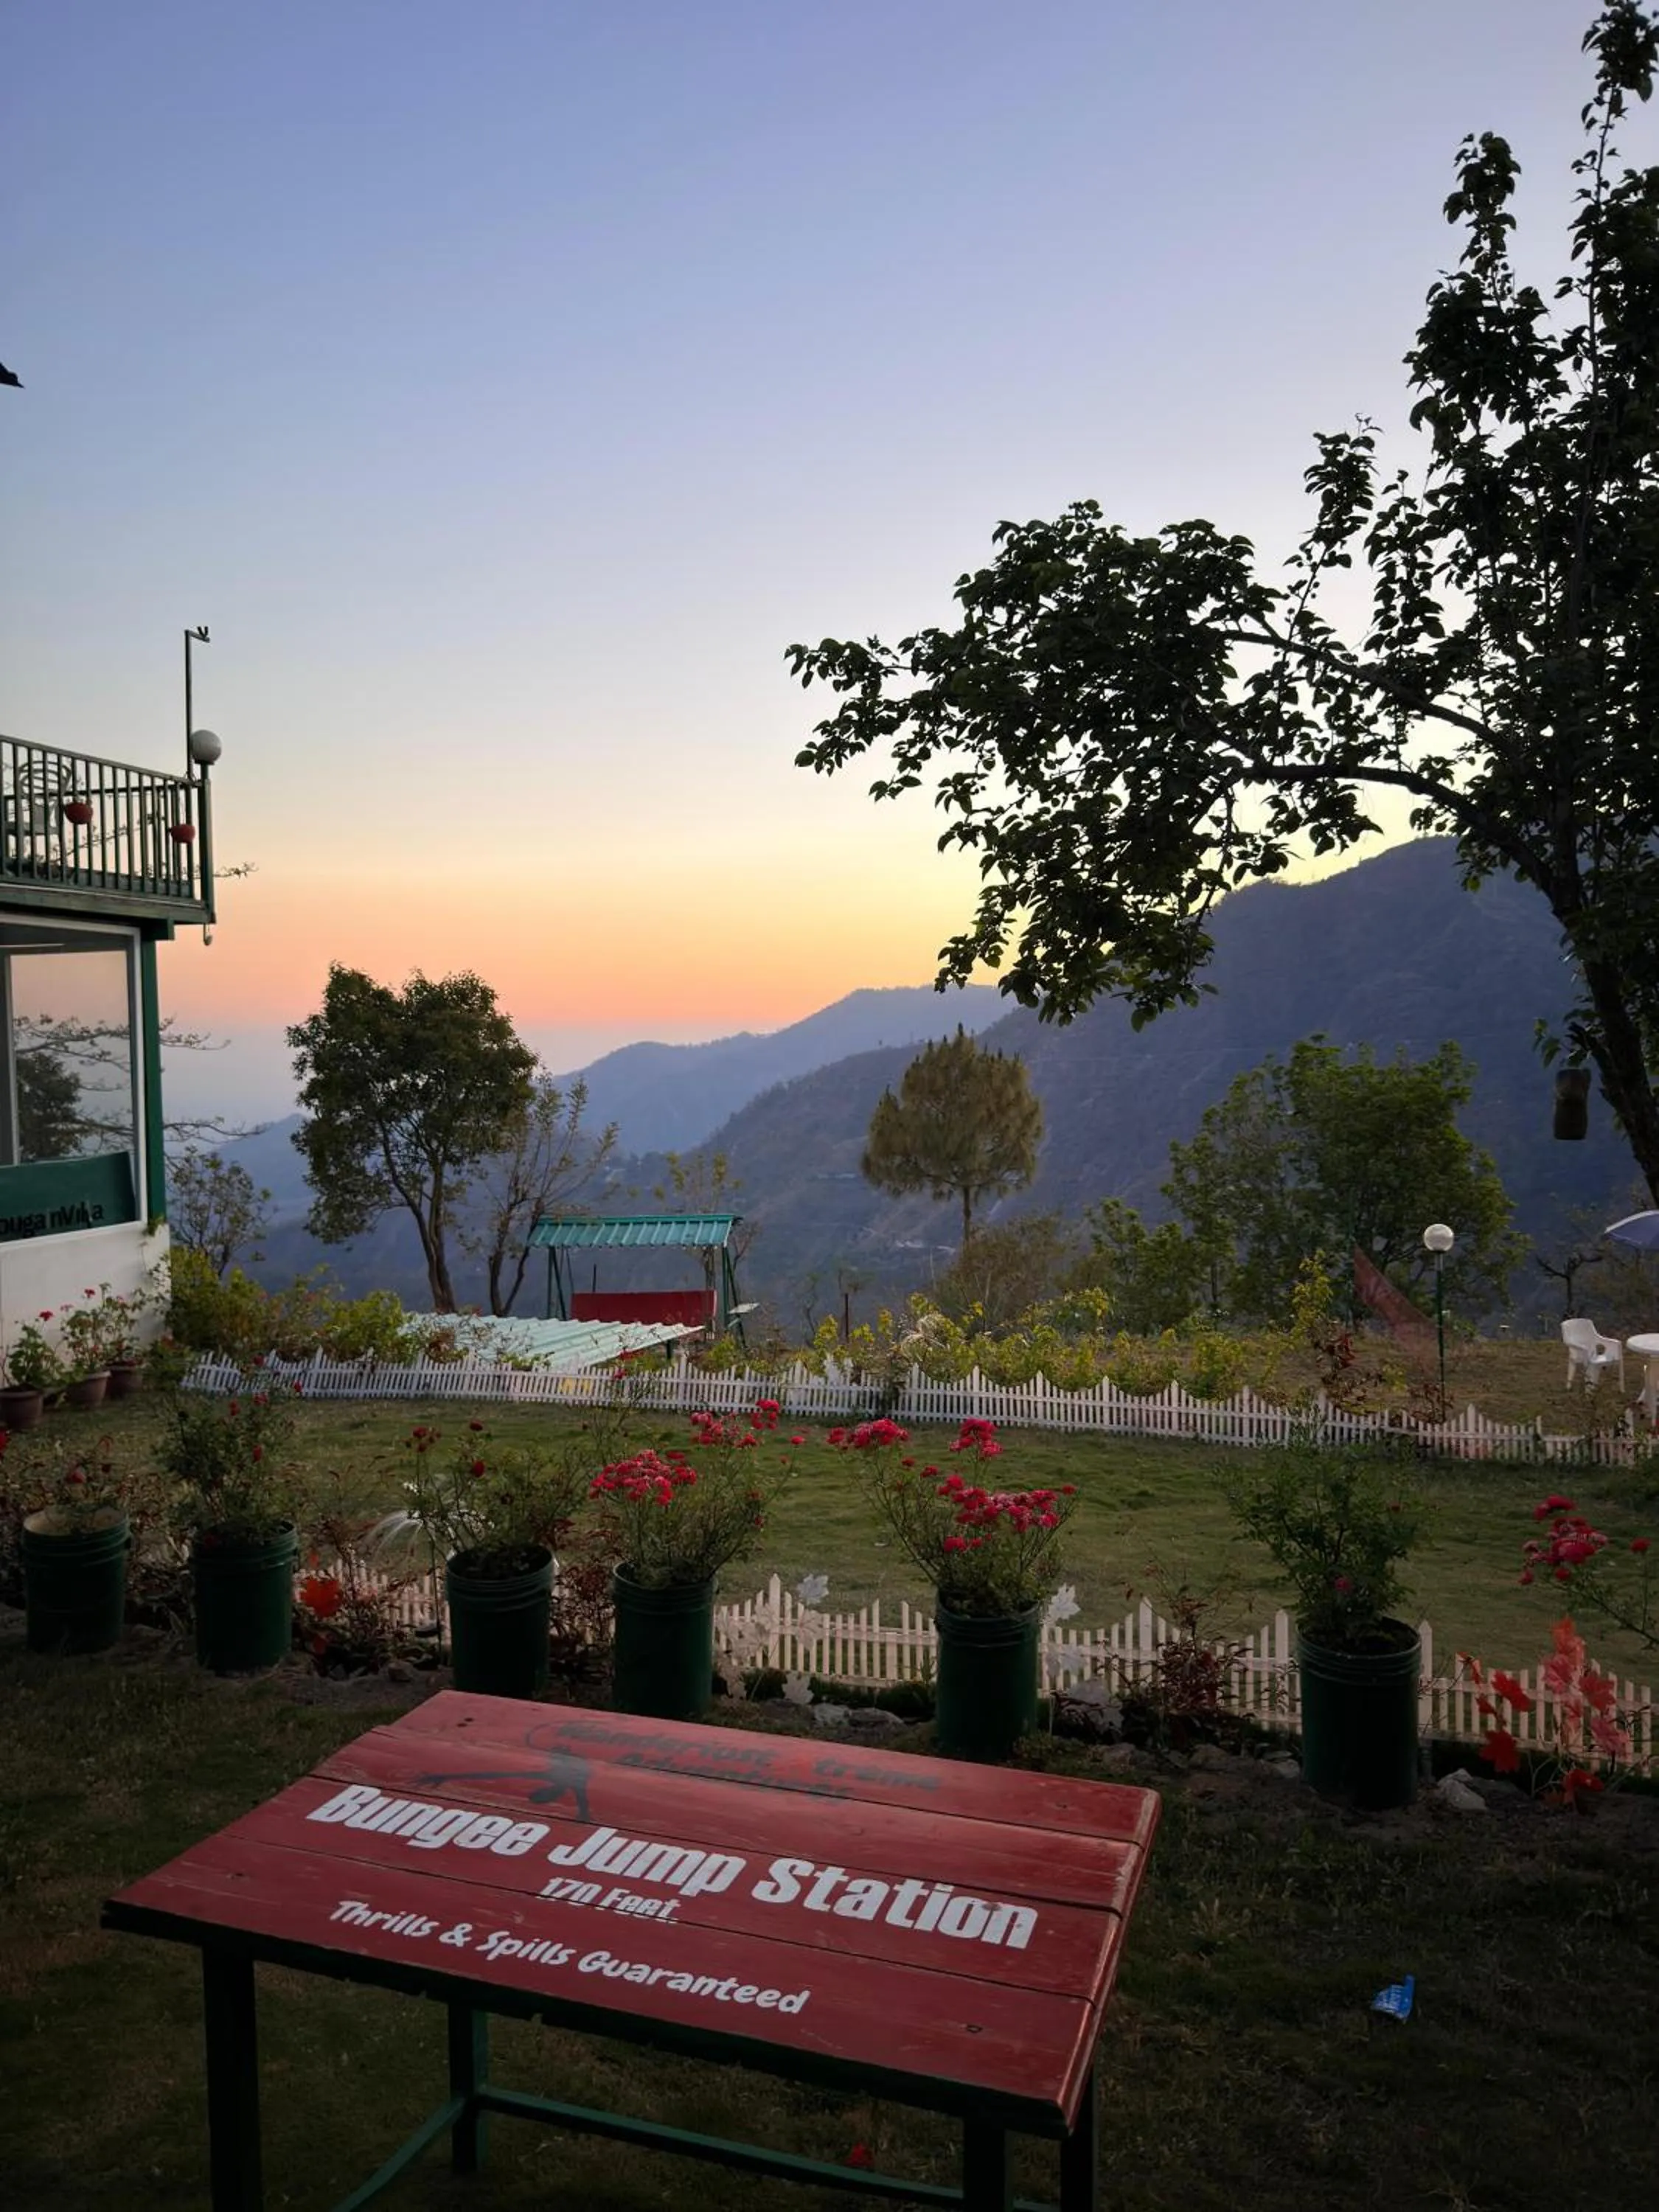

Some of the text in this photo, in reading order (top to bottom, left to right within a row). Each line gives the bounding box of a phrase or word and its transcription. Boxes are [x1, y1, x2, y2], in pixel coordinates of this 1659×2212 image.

[306, 1784, 1038, 1950] Bungee Jump Station
[536, 1877, 681, 1924] 170 Feet
[330, 1900, 810, 2014] Thrills & Spills Guaranteed
